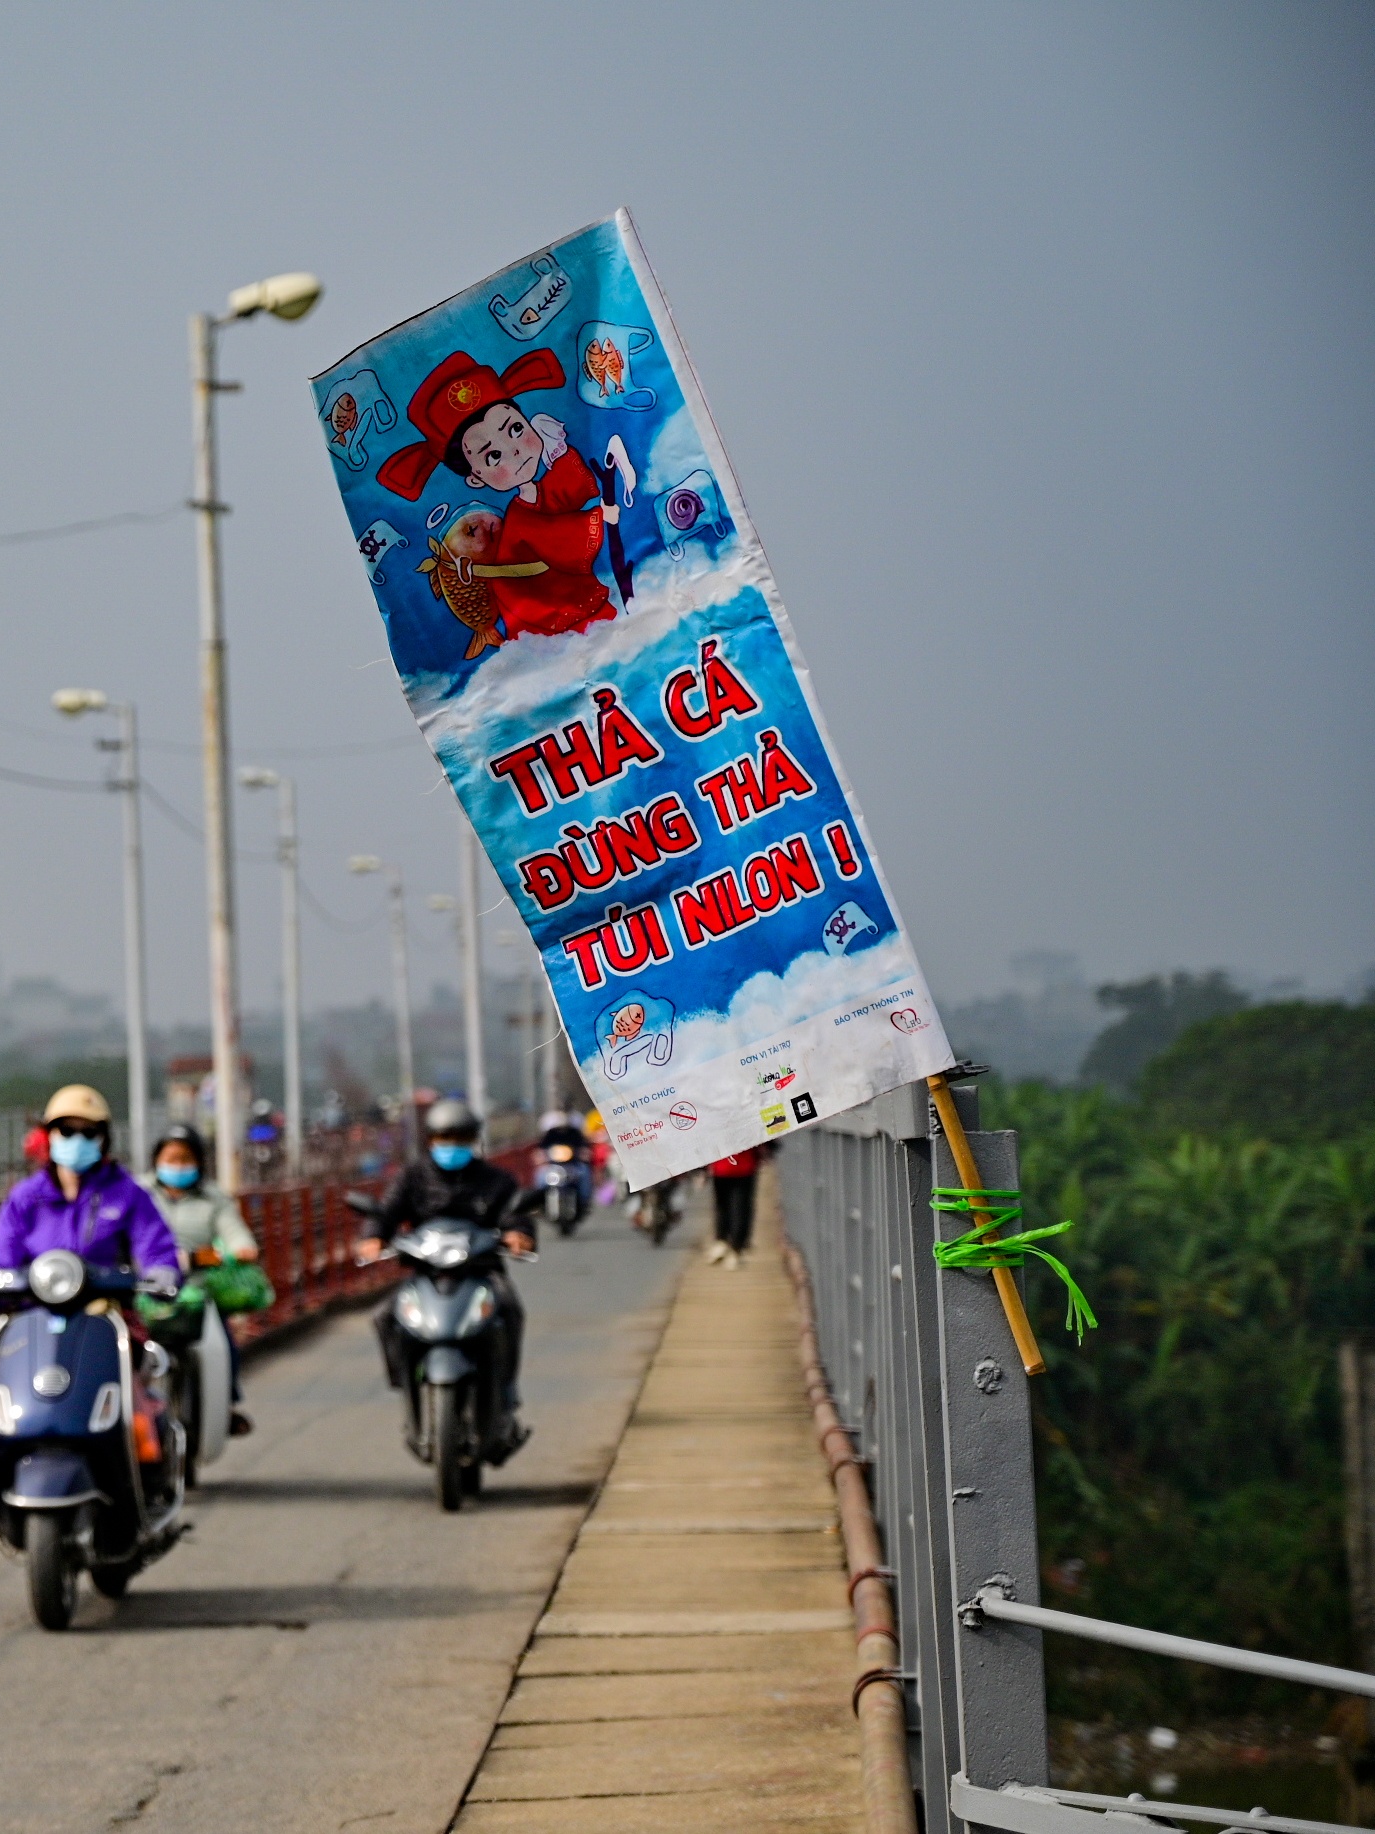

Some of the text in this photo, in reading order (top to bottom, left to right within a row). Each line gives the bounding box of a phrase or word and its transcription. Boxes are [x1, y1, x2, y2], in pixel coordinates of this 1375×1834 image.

[491, 640, 758, 813] THẢ CÁ
[519, 730, 814, 911] ĐỪNG THẢ
[562, 905, 670, 988] TÚI
[673, 836, 820, 946] NILON
[852, 1006, 870, 1019] TRỢ
[870, 994, 899, 1010] THÔNG
[899, 989, 914, 999] TIN
[629, 1100, 639, 1109] VỊ
[651, 1087, 675, 1100] CHỨC
